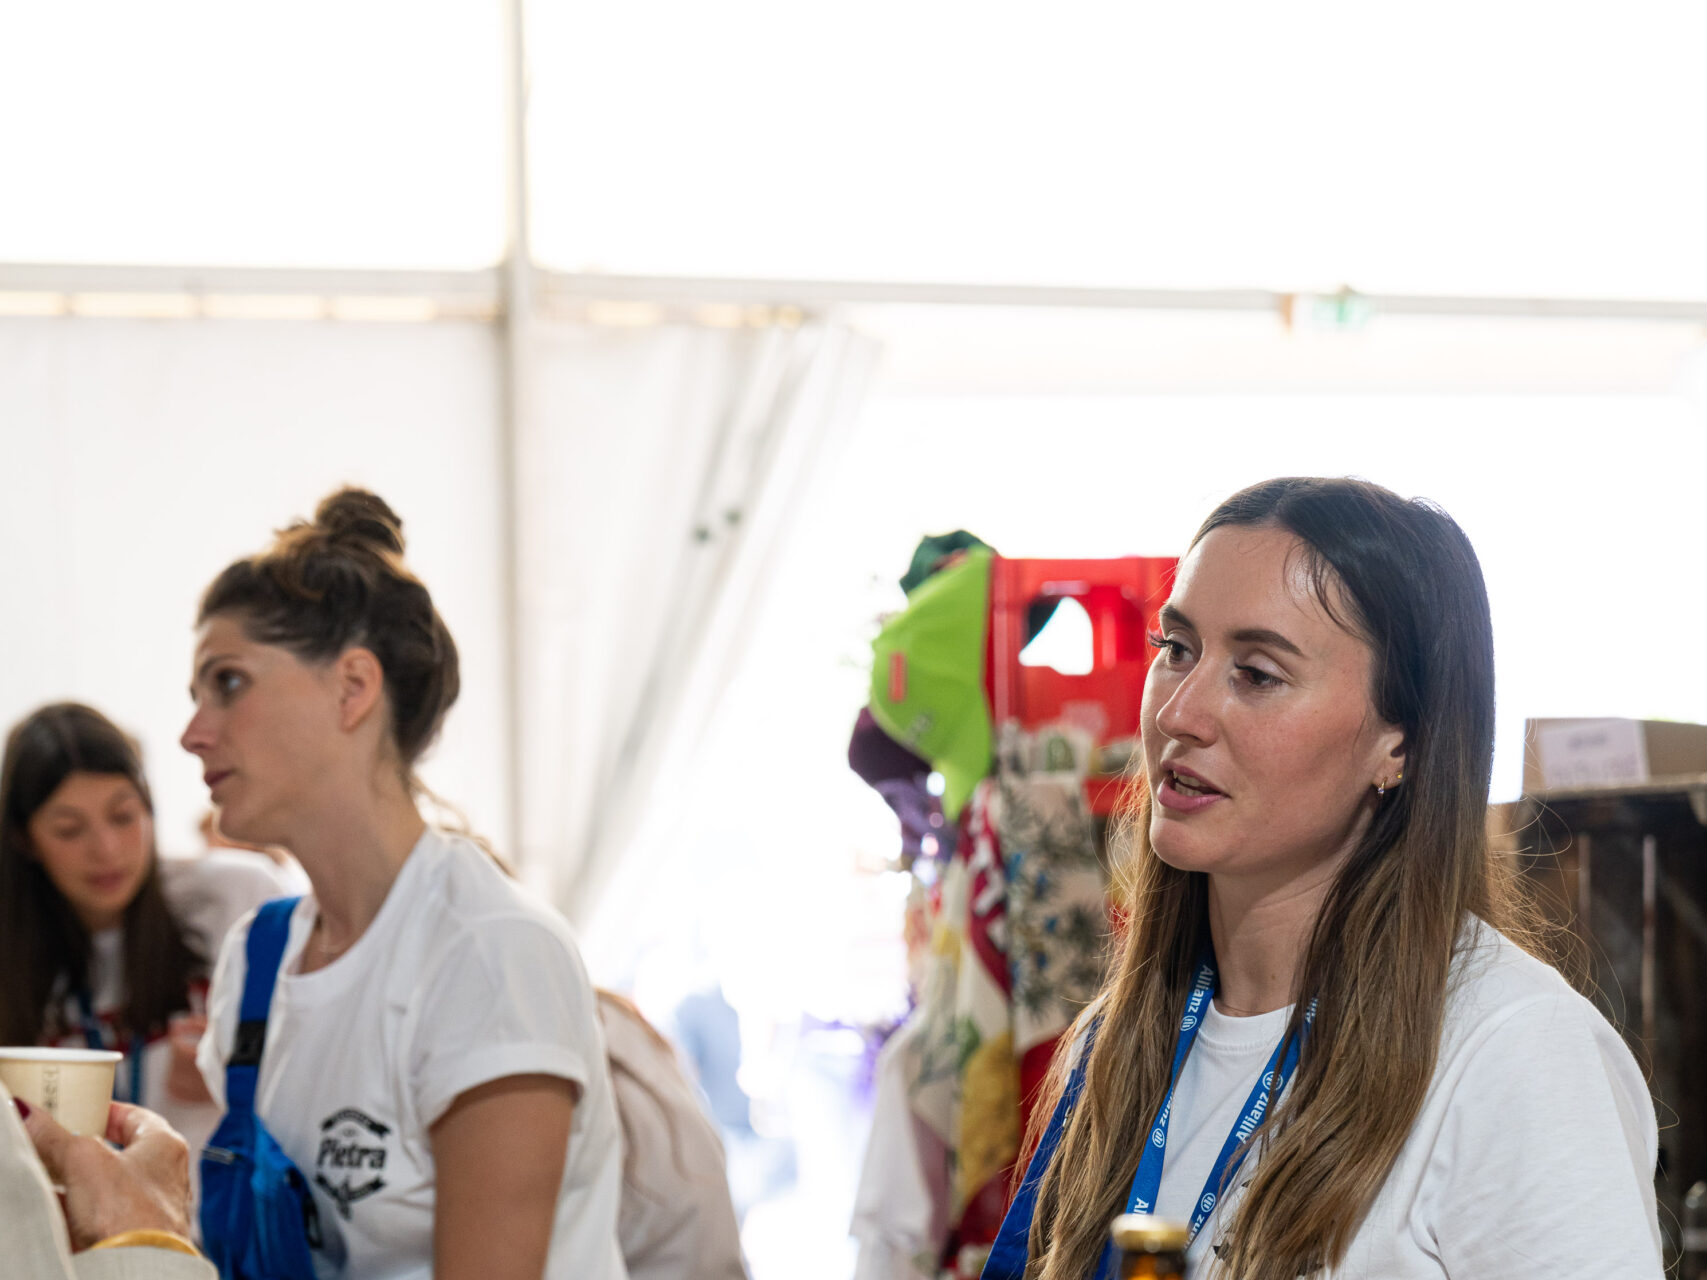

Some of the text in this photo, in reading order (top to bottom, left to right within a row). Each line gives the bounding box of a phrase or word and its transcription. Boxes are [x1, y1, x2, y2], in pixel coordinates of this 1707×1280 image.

[1187, 963, 1215, 1014] Allianz
[1235, 1091, 1270, 1145] Allianz
[317, 1138, 386, 1170] Pietra
